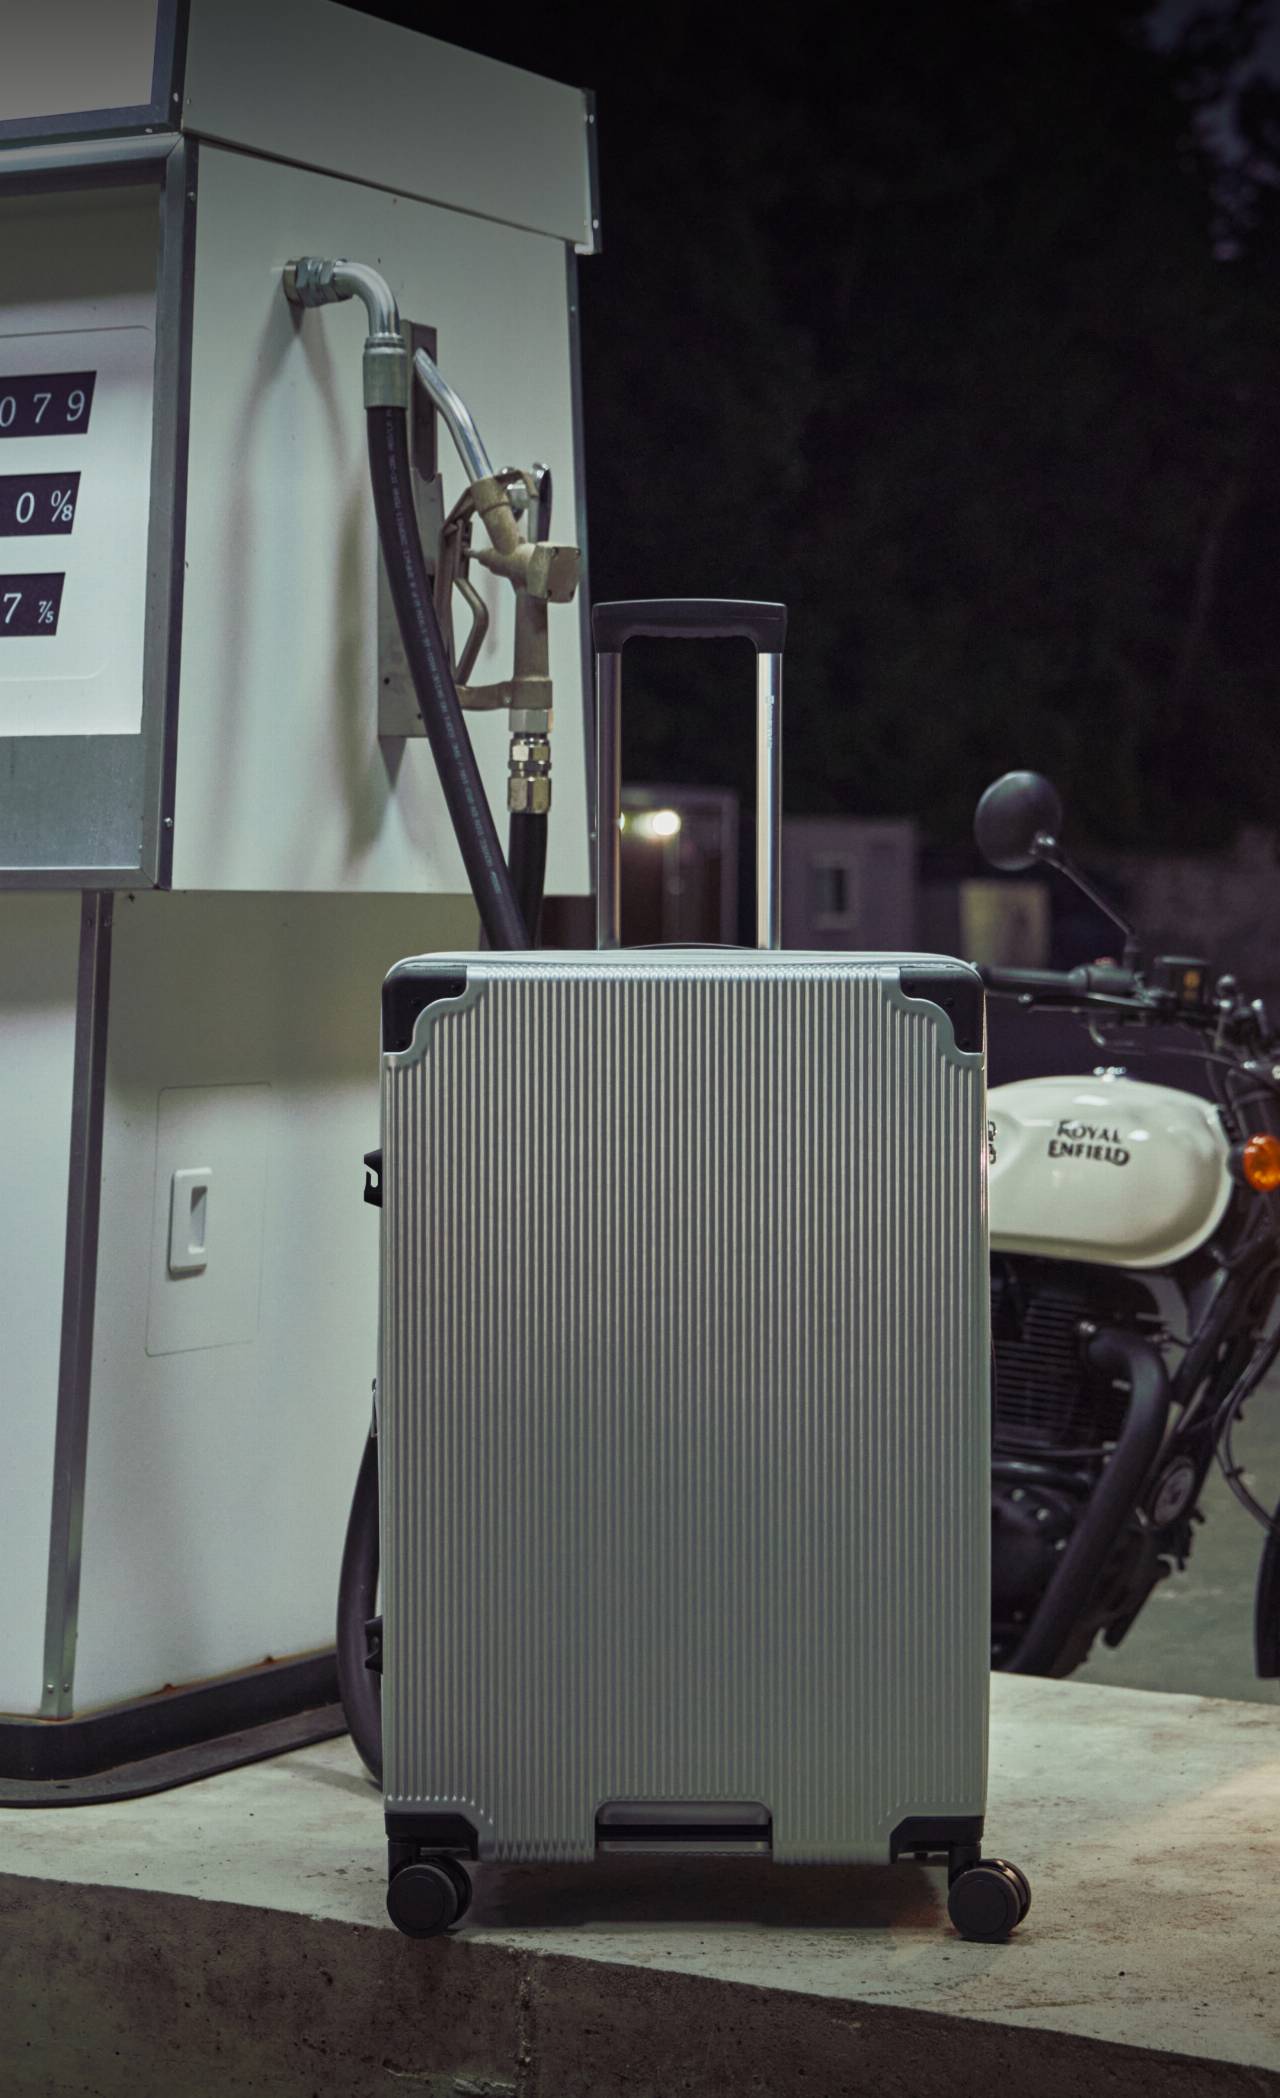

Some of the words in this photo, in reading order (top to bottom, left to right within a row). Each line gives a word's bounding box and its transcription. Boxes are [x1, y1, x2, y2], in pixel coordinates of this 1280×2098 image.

[3, 592, 23, 624] 7
[1057, 1119, 1122, 1145] ROYAL
[1047, 1138, 1131, 1167] ENFIELD
